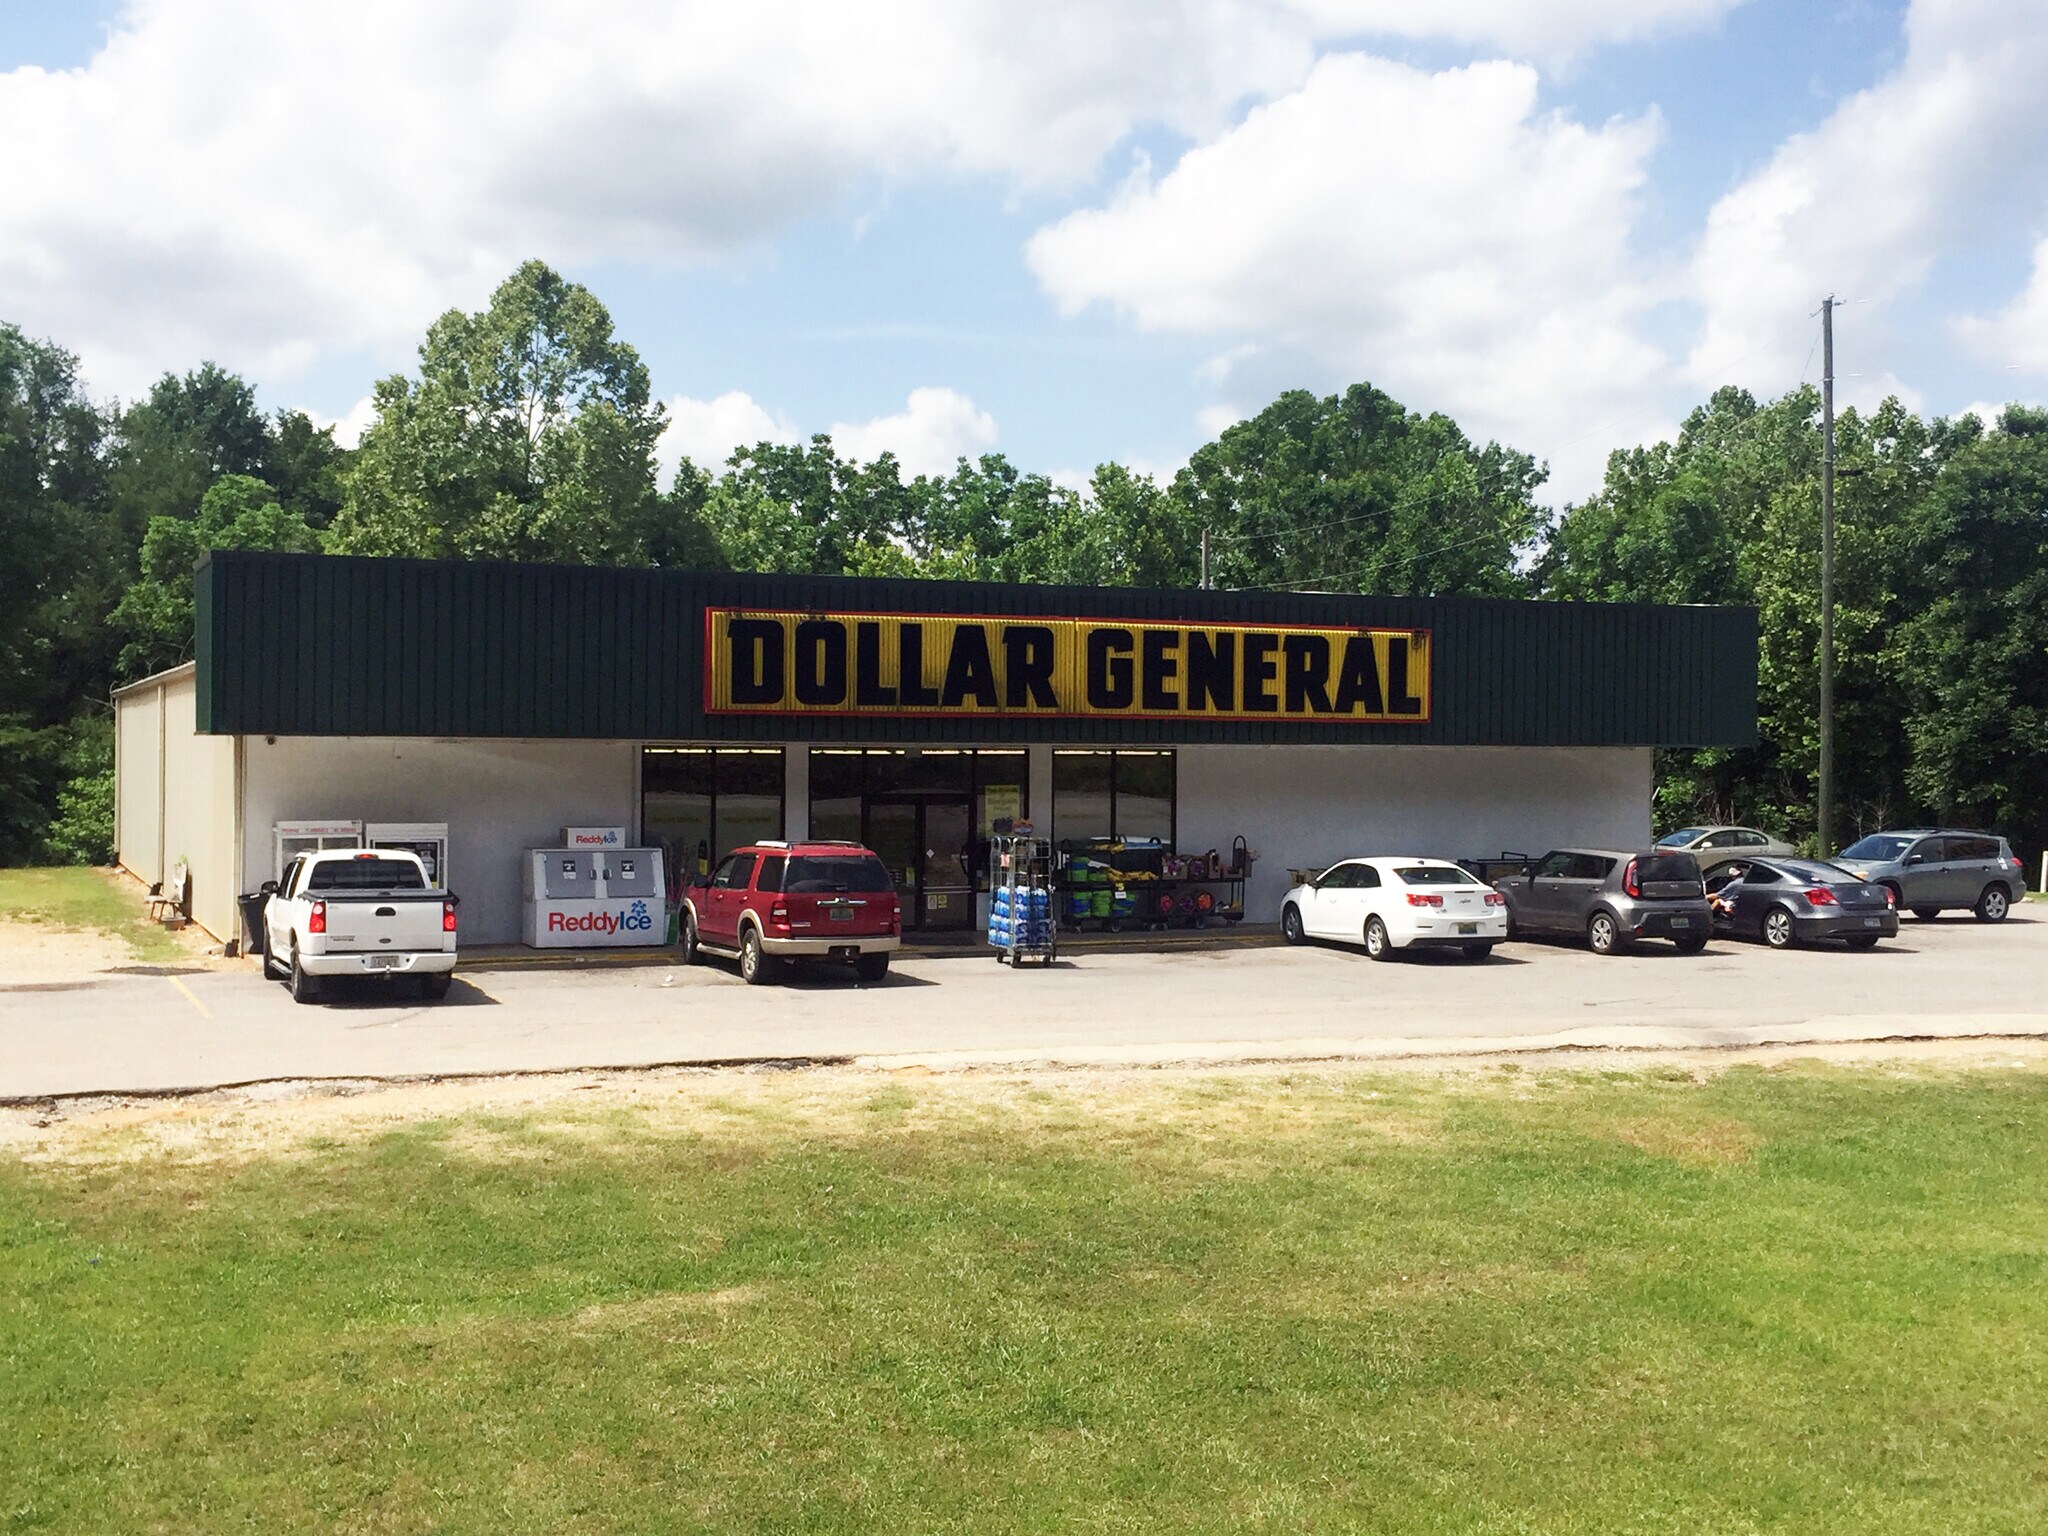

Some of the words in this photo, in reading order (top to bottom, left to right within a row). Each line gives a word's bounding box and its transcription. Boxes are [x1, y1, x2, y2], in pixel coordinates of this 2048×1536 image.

[727, 619, 1060, 708] DOLLAR
[1087, 628, 1421, 714] GENERAL
[548, 911, 652, 935] ReddyIce
